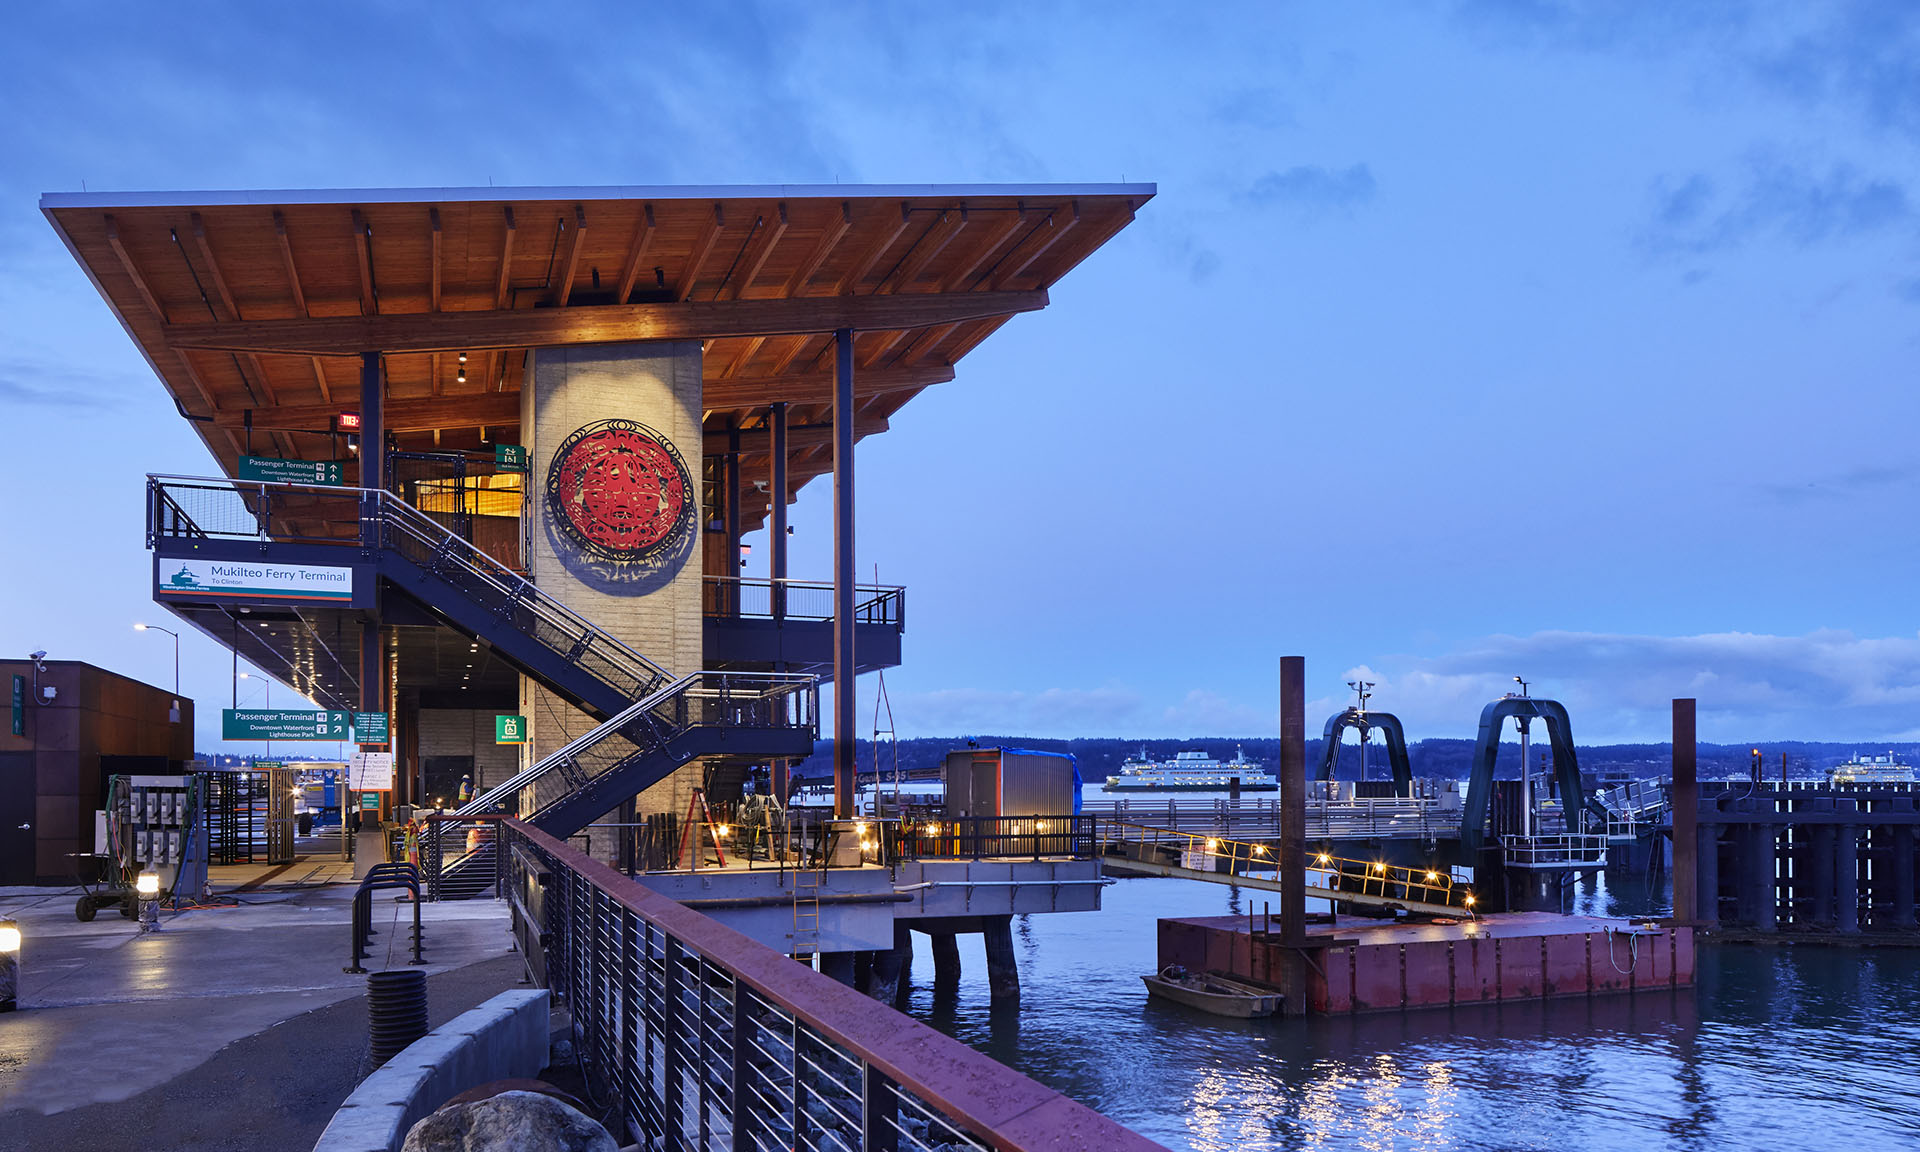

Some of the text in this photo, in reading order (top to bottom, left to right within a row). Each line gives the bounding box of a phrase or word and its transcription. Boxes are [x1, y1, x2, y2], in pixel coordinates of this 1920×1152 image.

[249, 459, 314, 470] Passenger Terminal
[211, 566, 346, 582] Mukilteo Ferry Terminal
[221, 578, 243, 586] Clinton
[235, 713, 315, 722] Passenger Terminal
